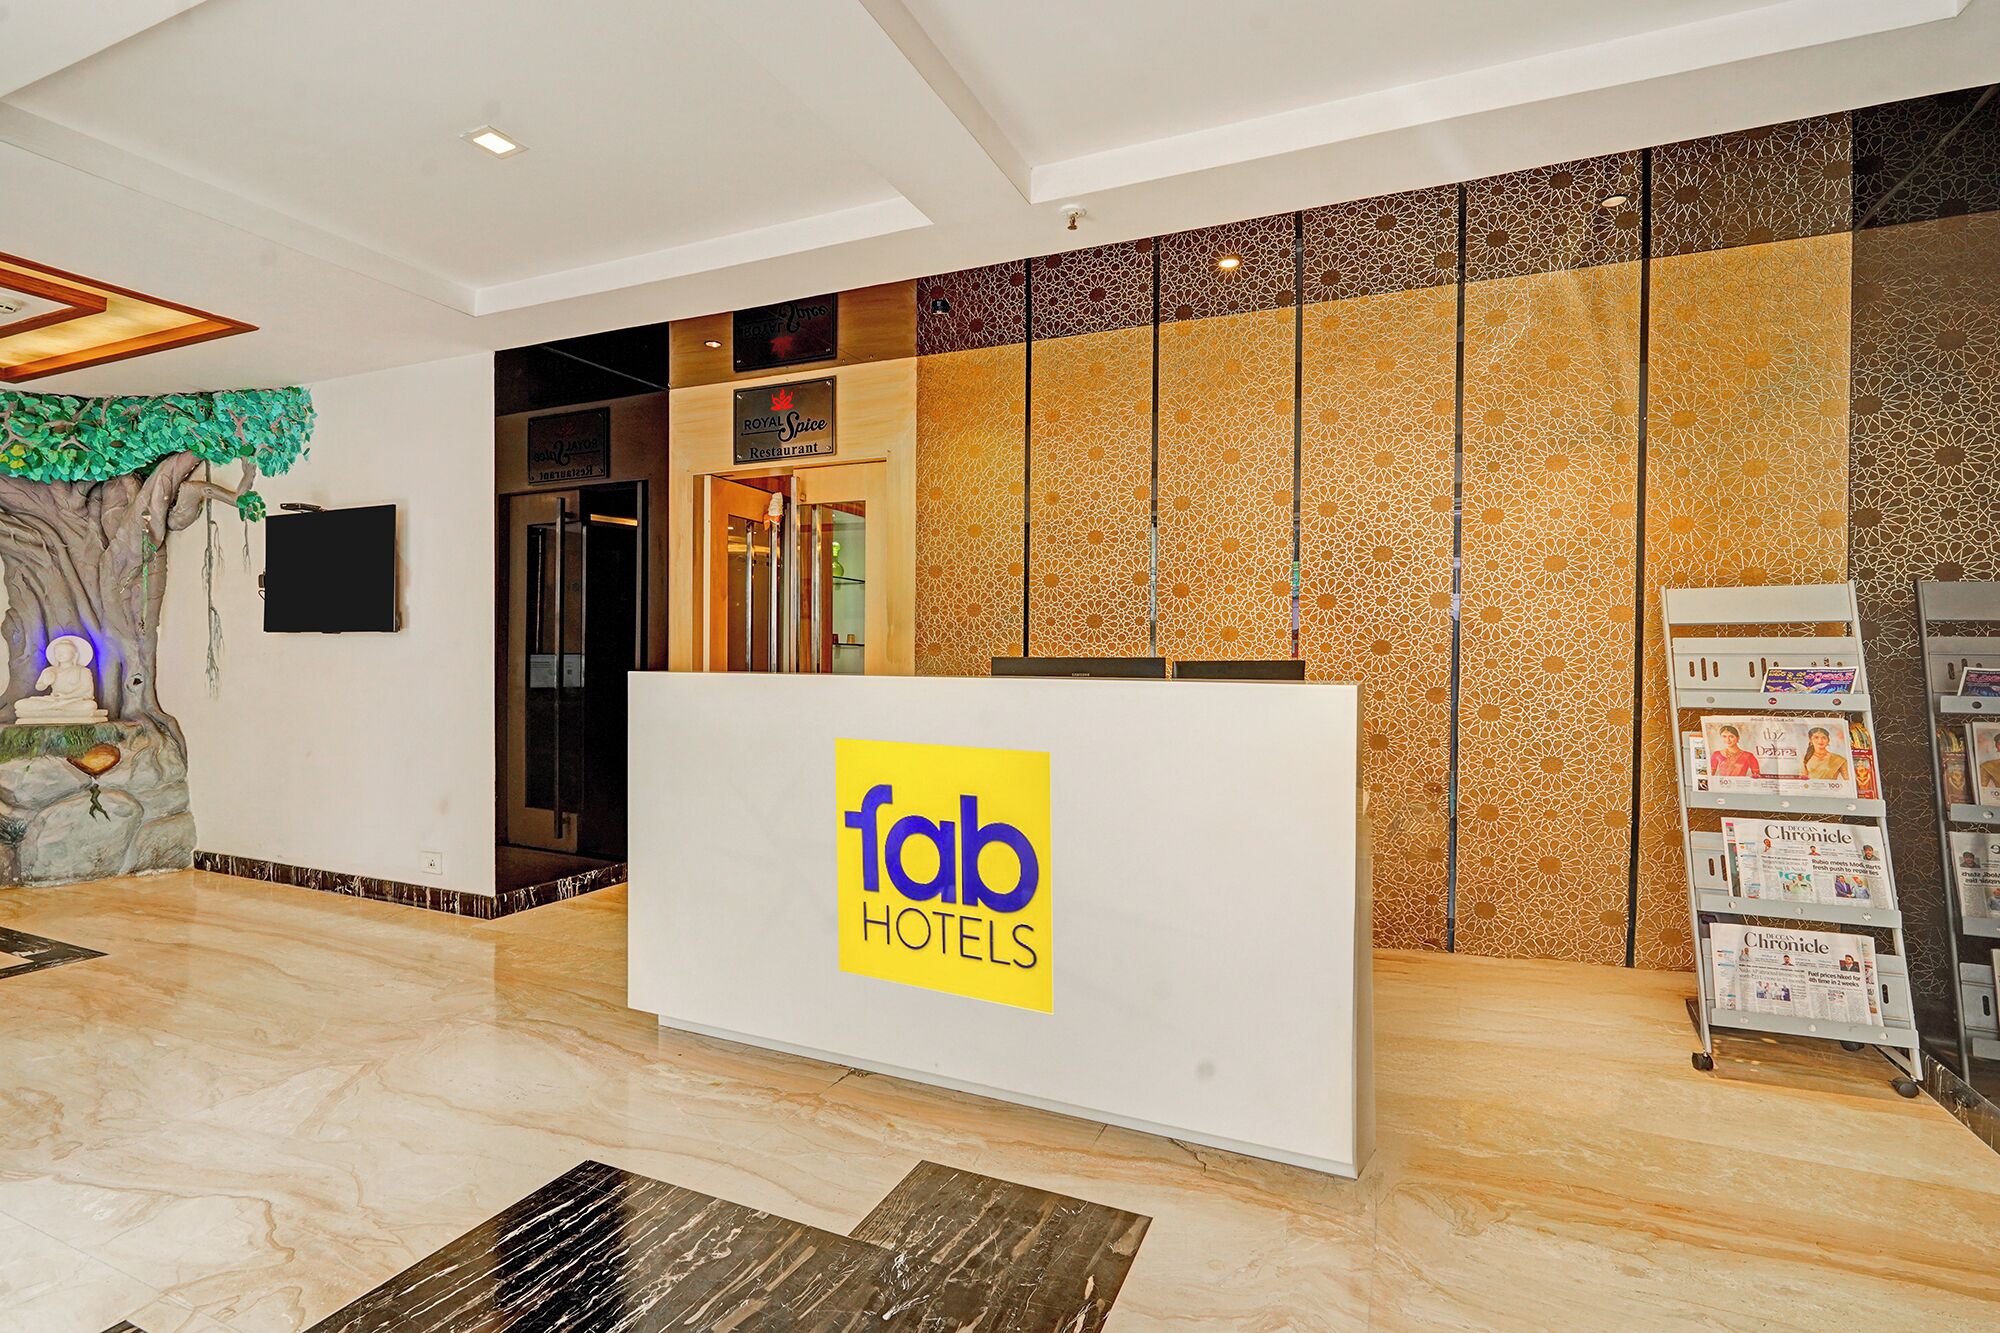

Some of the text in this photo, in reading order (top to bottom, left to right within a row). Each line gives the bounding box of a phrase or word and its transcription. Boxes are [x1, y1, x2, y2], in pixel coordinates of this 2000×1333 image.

[744, 411, 827, 442] ROYAL Spice
[750, 443, 818, 459] Restaurant
[1764, 824, 1852, 844] Chronicle
[1788, 825, 1818, 833] DECCAN
[844, 784, 1039, 913] fab
[863, 901, 1037, 969] HOTELS
[1744, 931, 1830, 955] Chronicle
[1766, 933, 1795, 941] DECCAN
